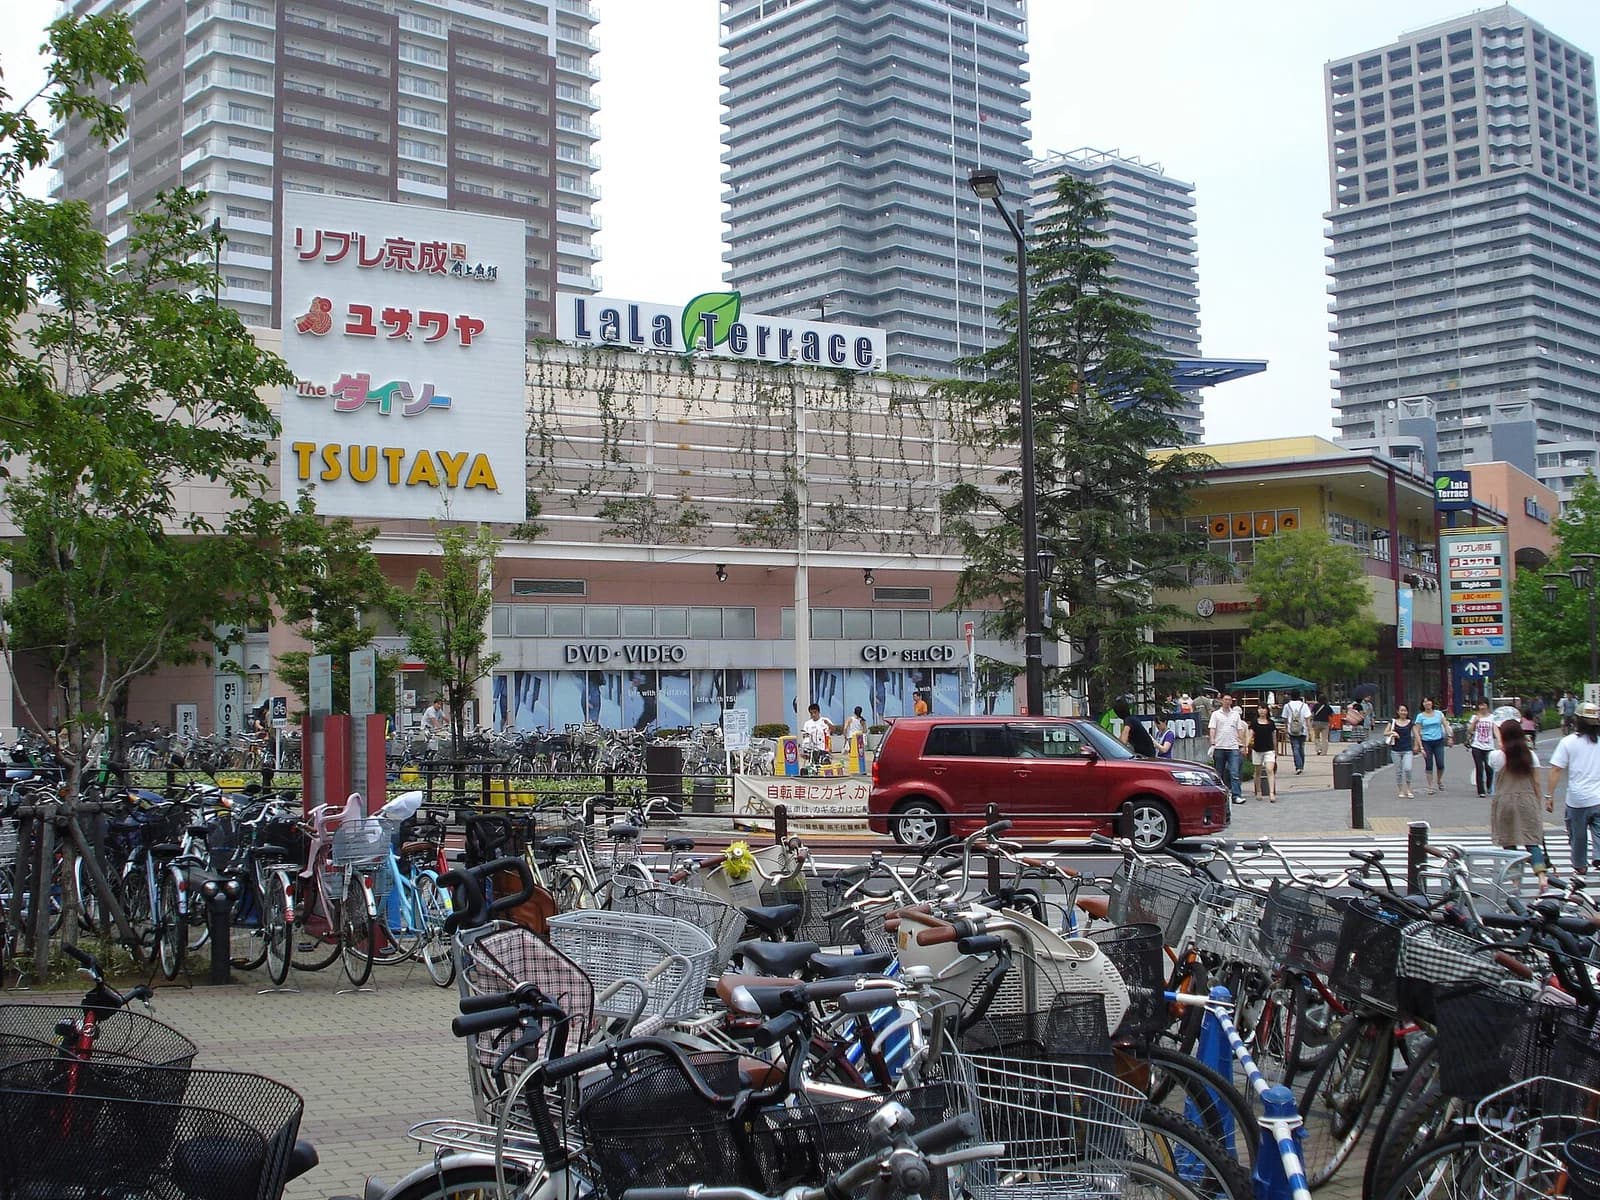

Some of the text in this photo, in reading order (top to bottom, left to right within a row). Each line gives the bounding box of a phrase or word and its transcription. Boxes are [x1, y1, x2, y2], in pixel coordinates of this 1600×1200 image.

[294, 226, 448, 275] リブレ京成
[344, 303, 486, 347] ユザワヤ
[574, 297, 874, 367] LaLa Terrace
[297, 372, 452, 416] The ダイソー
[292, 441, 500, 491] TSUTAYA
[1479, 661, 1490, 675] P
